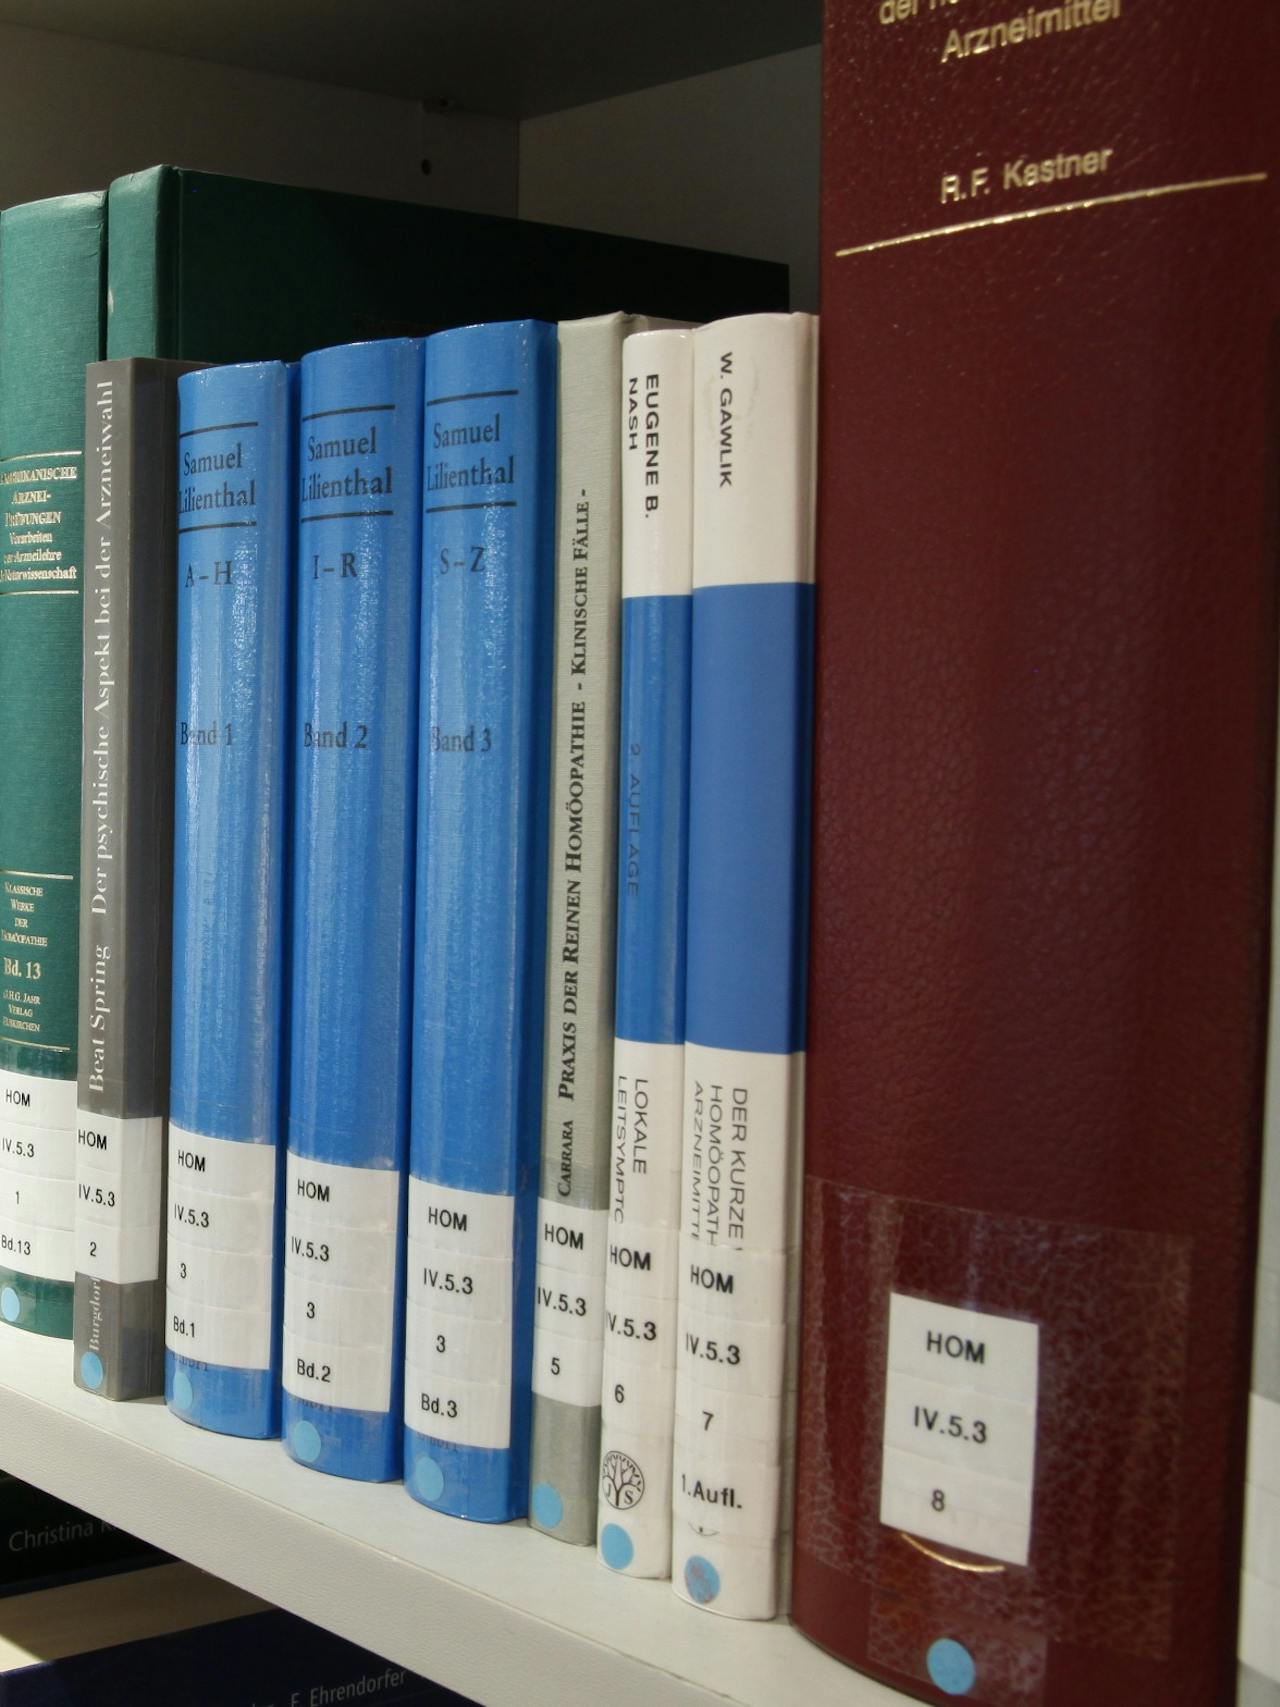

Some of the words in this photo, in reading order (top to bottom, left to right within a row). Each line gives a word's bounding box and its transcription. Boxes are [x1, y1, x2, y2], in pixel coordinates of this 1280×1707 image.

[941, 0, 1121, 62] Arzneimittel
[941, 169, 991, 203] R.F.
[1004, 148, 1114, 191] Kastner
[720, 352, 733, 379] W.
[629, 377, 638, 450] NASH
[308, 426, 376, 461] Samuel
[433, 413, 500, 449] Samuel
[646, 374, 659, 486] EUGENE
[720, 388, 733, 488] GAWLIK
[96, 381, 113, 529] Arzneiwahl
[184, 442, 242, 475] Samuel
[302, 465, 393, 502] Lilienthal
[427, 455, 514, 491] Lilienthal
[178, 479, 256, 514] Lilienthal
[645, 495, 658, 518] B.
[572, 501, 589, 560] FÄLLE
[95, 537, 111, 578] der
[94, 587, 110, 624] bei
[571, 567, 588, 675] KLINISCHE
[94, 634, 115, 719] Aspekt
[181, 721, 217, 745] Band
[224, 723, 233, 745] 1
[304, 721, 347, 748] Band
[353, 724, 368, 748] 2
[433, 726, 475, 752] Band
[481, 727, 492, 752] 3
[92, 726, 113, 859] psychische
[565, 701, 586, 872] HOMÖOPATHIE
[92, 867, 107, 914] Der
[562, 880, 582, 964] REINEN
[3, 957, 22, 978] Bd.
[26, 961, 41, 980] 13
[90, 945, 111, 1030] Spring
[564, 971, 578, 1015] DER
[88, 1040, 105, 1092] Beat
[558, 1022, 577, 1101] PRAXIS
[5, 1089, 30, 1107] HOM
[632, 1078, 648, 1174] LOKALE
[732, 1088, 748, 1142] DER
[2, 1137, 35, 1158] IV.5.3
[78, 1129, 107, 1151] HOM
[177, 1150, 205, 1172] HOM
[557, 1120, 574, 1197] CARRARA
[16, 1191, 20, 1204] 1
[79, 1184, 116, 1207] IV.5.3
[297, 1178, 330, 1202] HOM
[728, 1150, 746, 1239] KURZE
[174, 1203, 209, 1228] IV.5.3
[428, 1206, 467, 1231] HOM
[1, 1234, 31, 1256] Bd.13
[89, 1242, 97, 1257] 2
[292, 1236, 329, 1262] IV.5.3
[544, 1223, 584, 1250] HOM
[180, 1262, 187, 1279] 3
[610, 1245, 651, 1271] HOM
[424, 1268, 473, 1295] IV.5.3
[690, 1264, 734, 1294] HOM
[306, 1302, 315, 1319] 3
[538, 1287, 587, 1316] IV.5.3
[173, 1316, 195, 1338] Bd.1
[605, 1312, 656, 1341] IV.5.3
[436, 1335, 446, 1353] 3
[686, 1333, 740, 1365] IV.5.3
[926, 1331, 985, 1364] HOM
[297, 1358, 331, 1383] Bd.2
[551, 1357, 560, 1375] 5
[421, 1393, 458, 1418] Bd.3
[615, 1384, 624, 1403] 6
[702, 1411, 714, 1431] 7
[915, 1406, 987, 1444] IV.5.3
[931, 1490, 946, 1512] 8
[9, 1522, 94, 1552] Christina
[310, 1668, 406, 1707] Ehrendorfer
